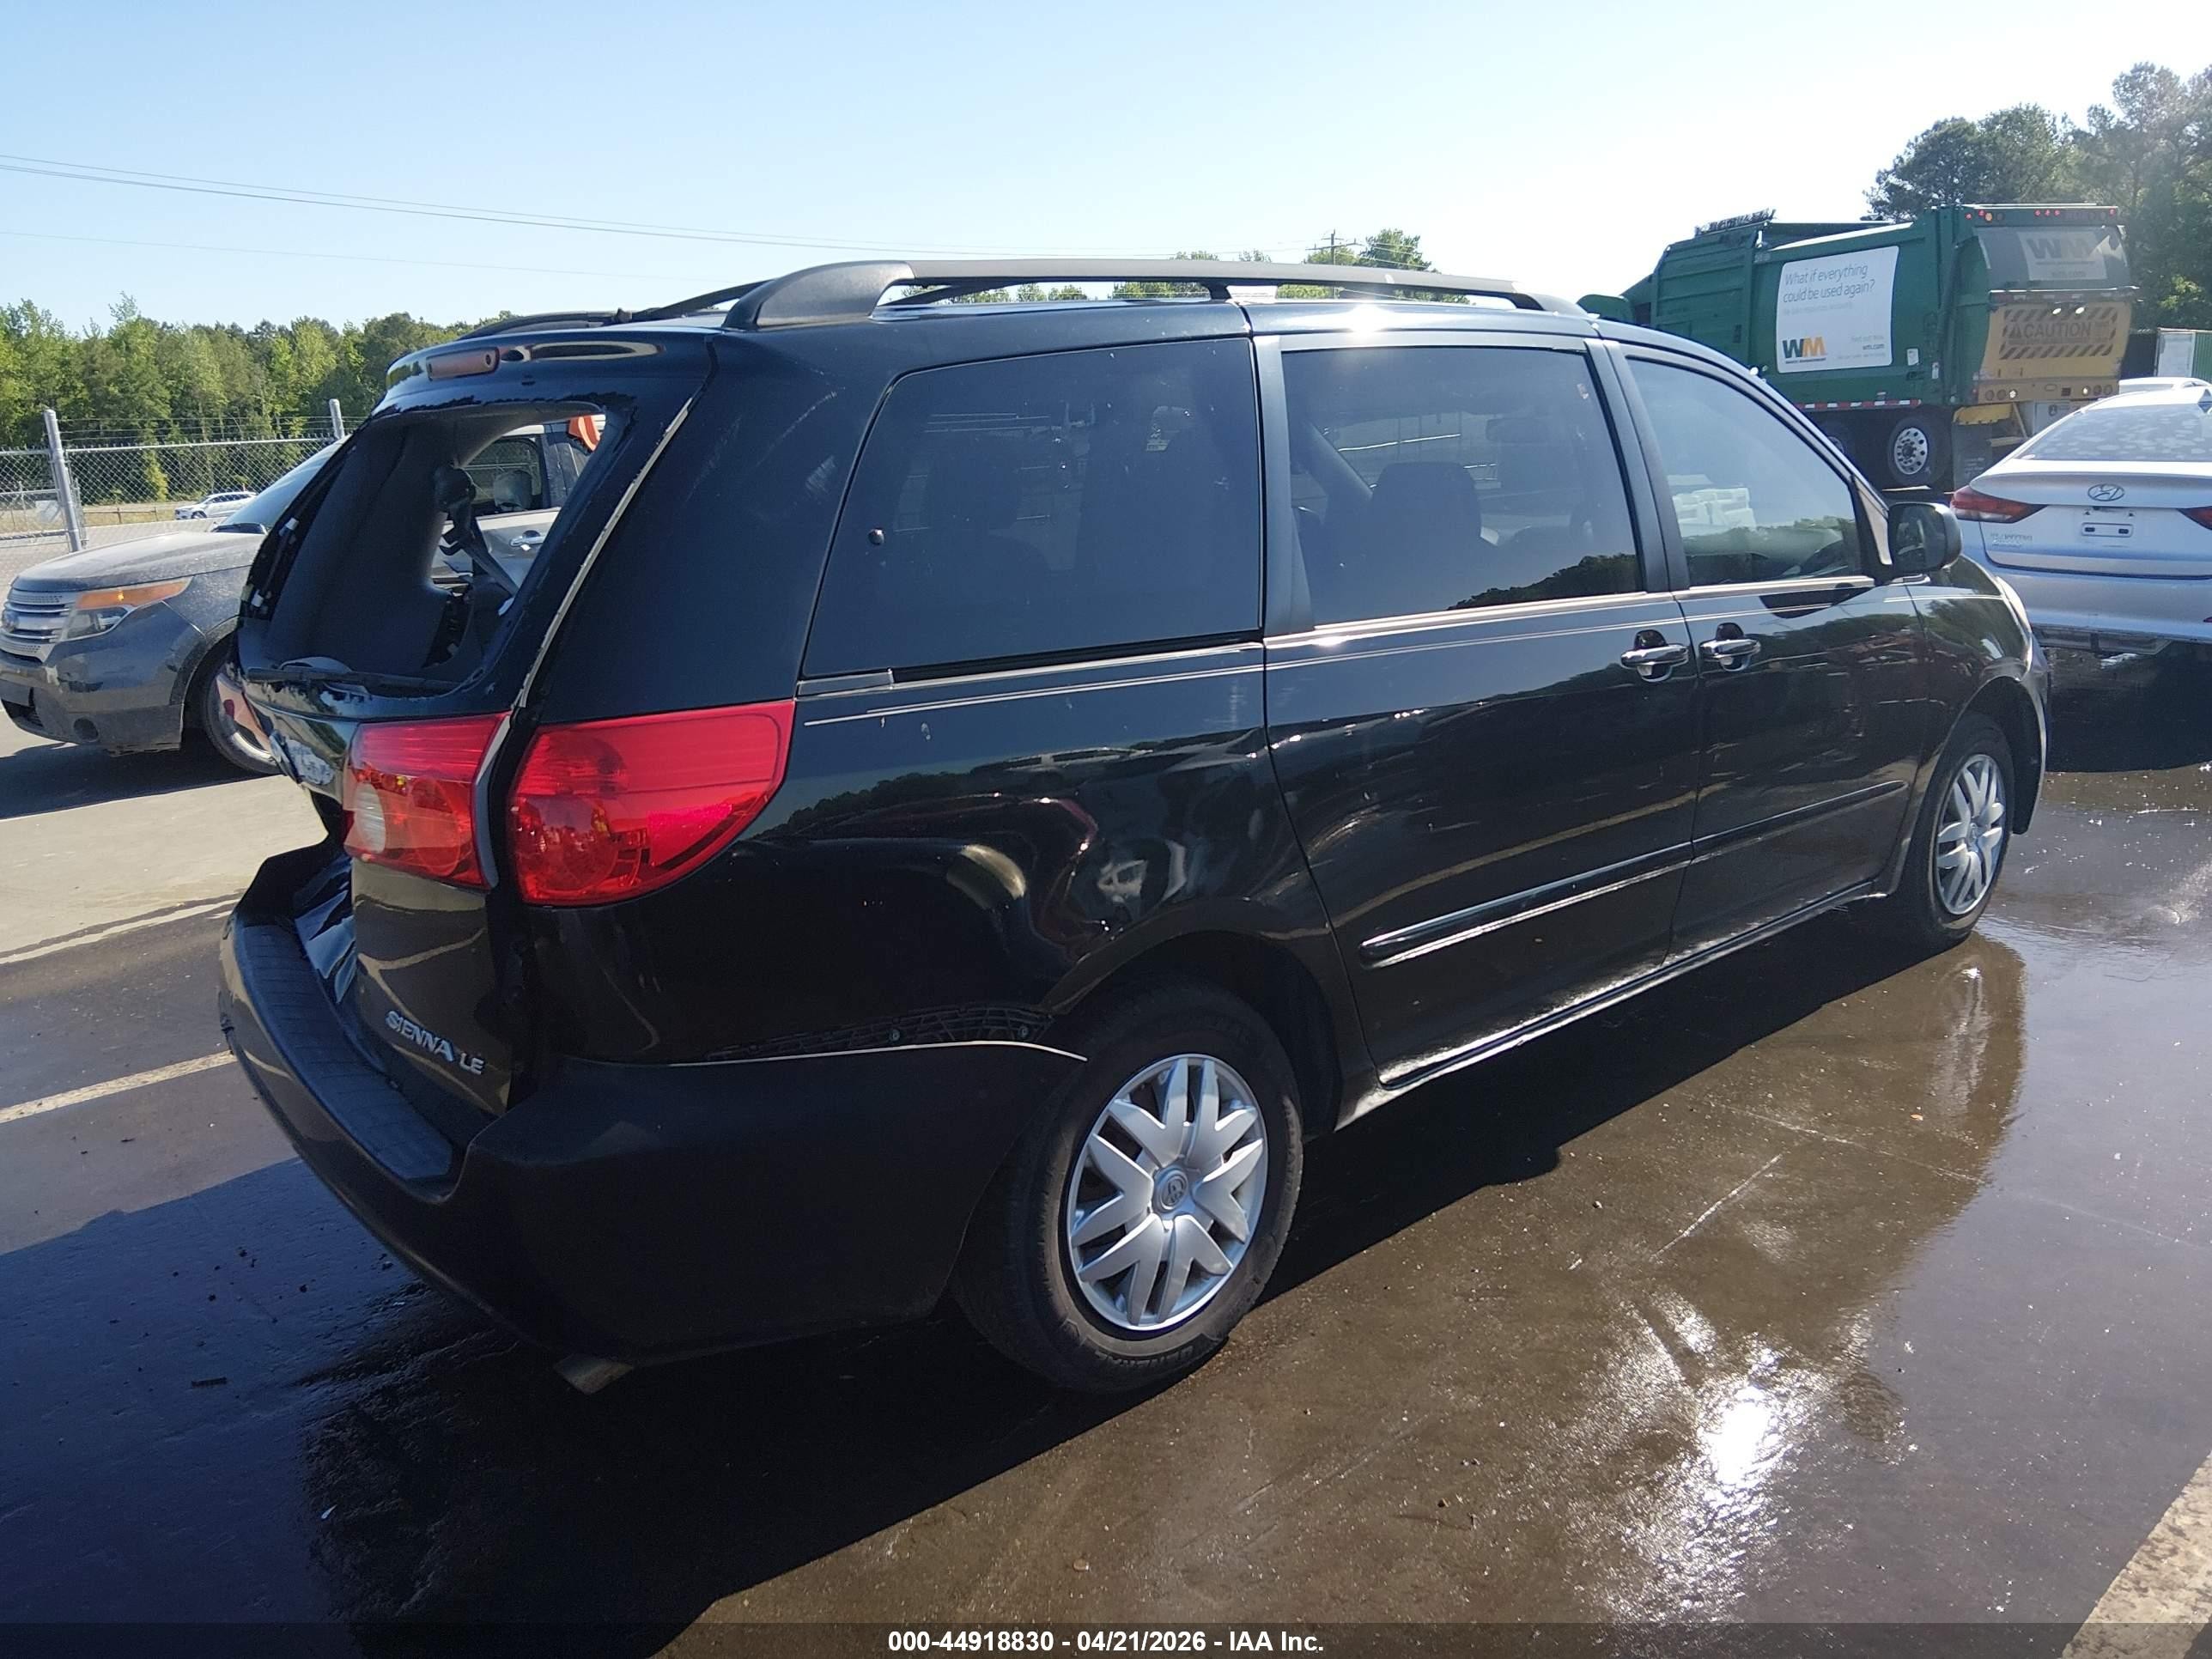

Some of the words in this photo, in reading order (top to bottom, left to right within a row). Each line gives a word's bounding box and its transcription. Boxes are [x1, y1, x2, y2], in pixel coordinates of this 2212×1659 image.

[1785, 270, 1808, 285] What
[1809, 268, 1818, 282] if
[1818, 264, 1869, 283] everything
[1783, 288, 1808, 303] could
[1808, 286, 1820, 300] be
[1820, 284, 1843, 298] used
[1844, 279, 1875, 298] again?
[2024, 321, 2092, 338] CAUTION
[1782, 336, 1828, 359] WM
[386, 1010, 454, 1062] SIENNA
[459, 1052, 486, 1075] LE
